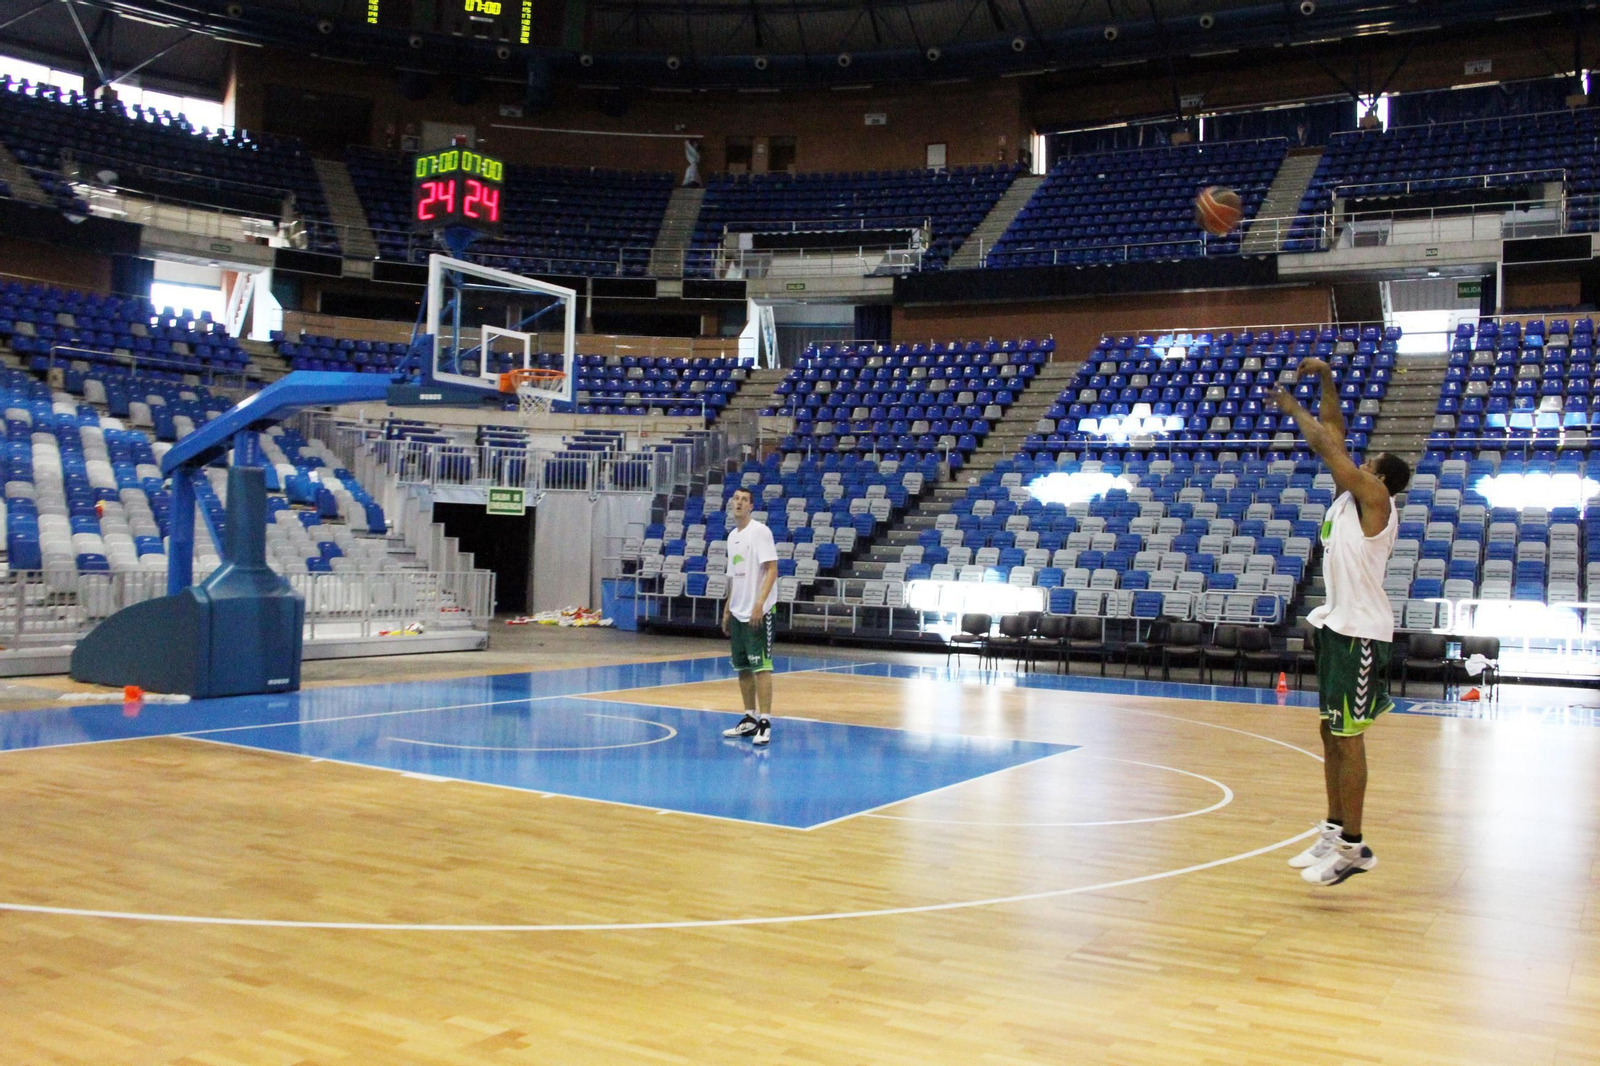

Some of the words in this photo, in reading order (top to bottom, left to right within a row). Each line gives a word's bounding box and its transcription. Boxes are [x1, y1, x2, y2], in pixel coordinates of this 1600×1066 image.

[465, 0, 501, 15] 07:00
[416, 151, 459, 177] 07:00
[461, 151, 502, 180] 07:00
[417, 179, 455, 220] 24
[463, 180, 499, 221] 24
[1458, 286, 1482, 294] SALIDA
